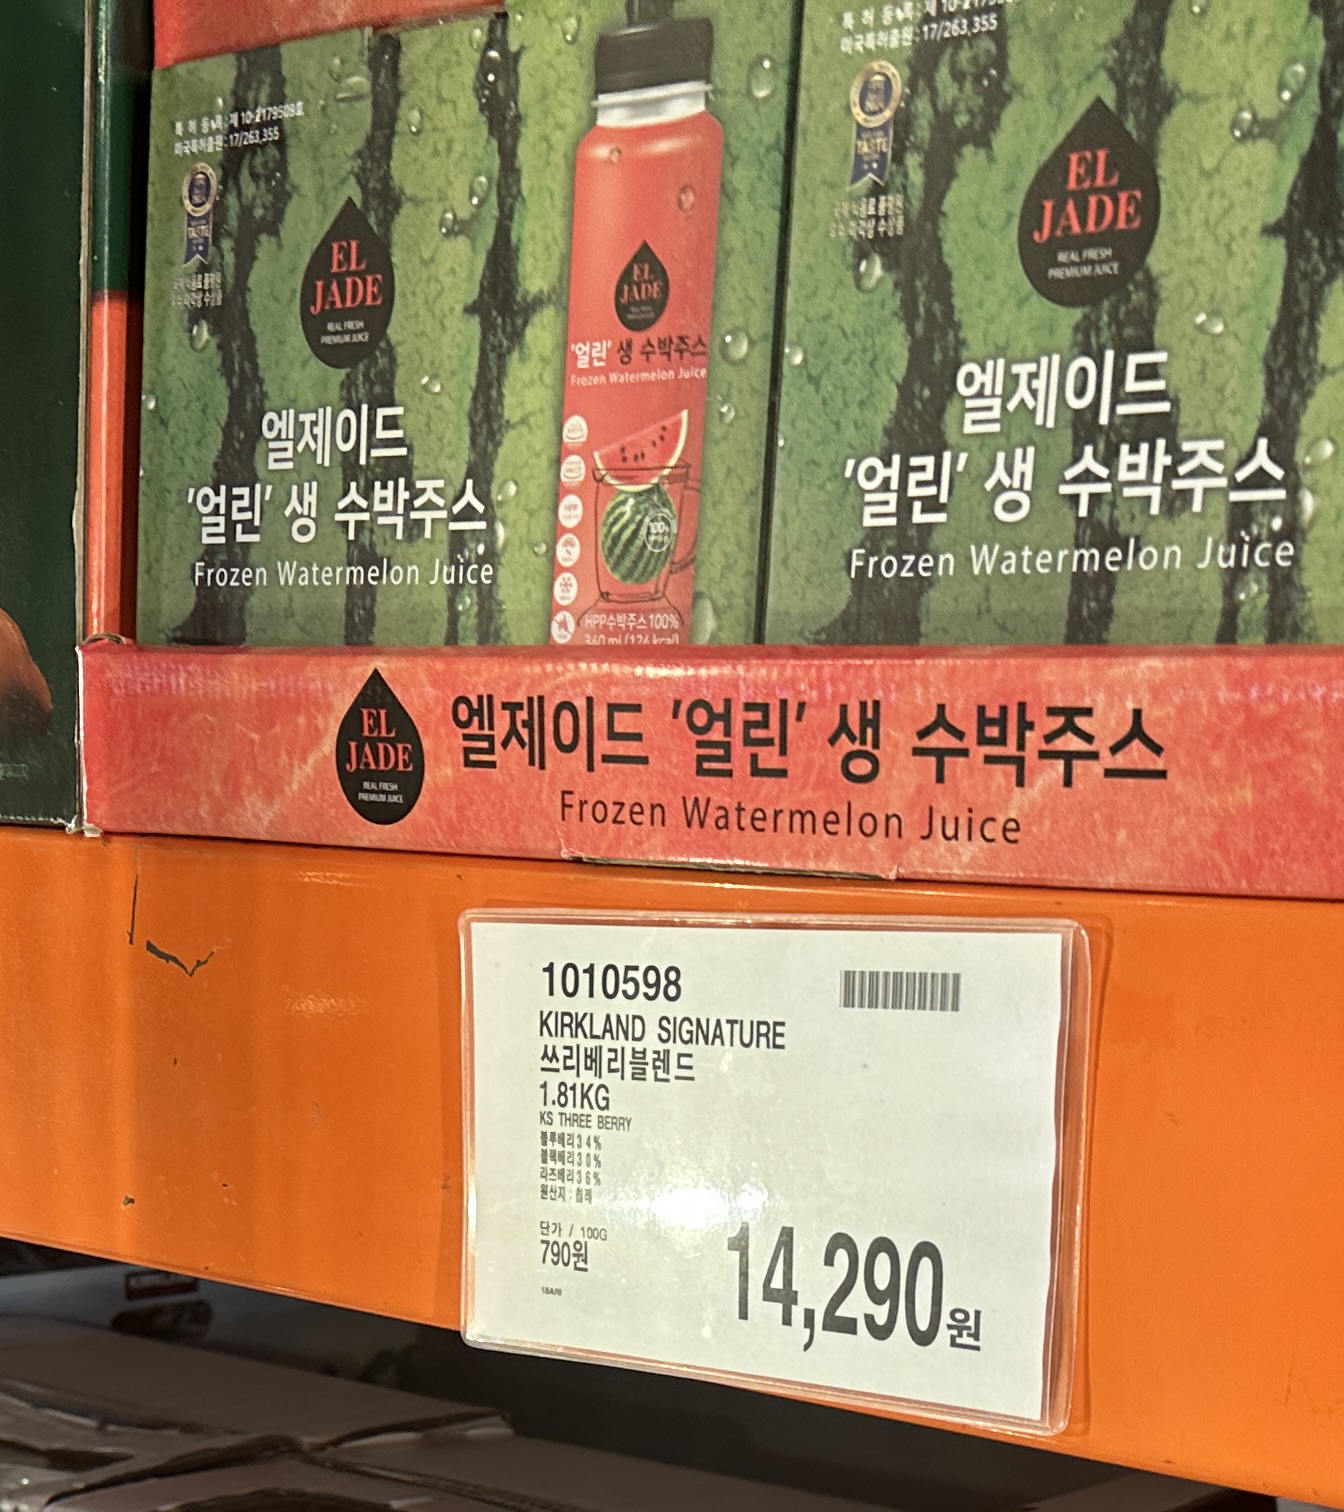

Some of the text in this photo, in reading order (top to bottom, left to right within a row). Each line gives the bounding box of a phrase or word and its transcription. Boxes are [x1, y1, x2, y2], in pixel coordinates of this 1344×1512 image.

[1066, 148, 1121, 191] EL
[1032, 189, 1143, 244] JADE
[330, 240, 367, 273] EL
[310, 273, 384, 315] JADE
[619, 281, 664, 305] JADE
[617, 338, 633, 365] 생
[640, 335, 708, 364] 수박주스
[570, 366, 708, 387] Frozen Watermelon Juice
[955, 350, 1172, 436] 엘제이드
[261, 405, 408, 470] 엘제이드
[985, 444, 1035, 525] 생
[1058, 437, 1287, 520] 수박주스
[284, 481, 318, 539] 생
[334, 478, 487, 541] 수박주스
[193, 554, 494, 588] Frozen Watermelon Juice
[848, 531, 1296, 581] Frozen Watermelon Juice
[649, 613, 680, 630] 100%
[359, 708, 396, 738] EL
[451, 693, 651, 773] 엘제이드
[828, 702, 882, 783] 생
[911, 700, 1170, 789] 수박주스
[345, 741, 414, 773] JADE
[560, 789, 1022, 847] Frozen Watermelon Juice
[542, 961, 682, 1002] 1010598
[539, 1010, 786, 1050] KIRKLAND SIGNATURE
[540, 1043, 695, 1084] 쓰리베리블렌드
[539, 1080, 610, 1111] 1.81KG
[539, 1110, 632, 1132] KS THREE BERRY
[539, 1220, 563, 1238] 단가
[580, 1226, 608, 1242] 100G
[540, 1239, 589, 1273] 790원
